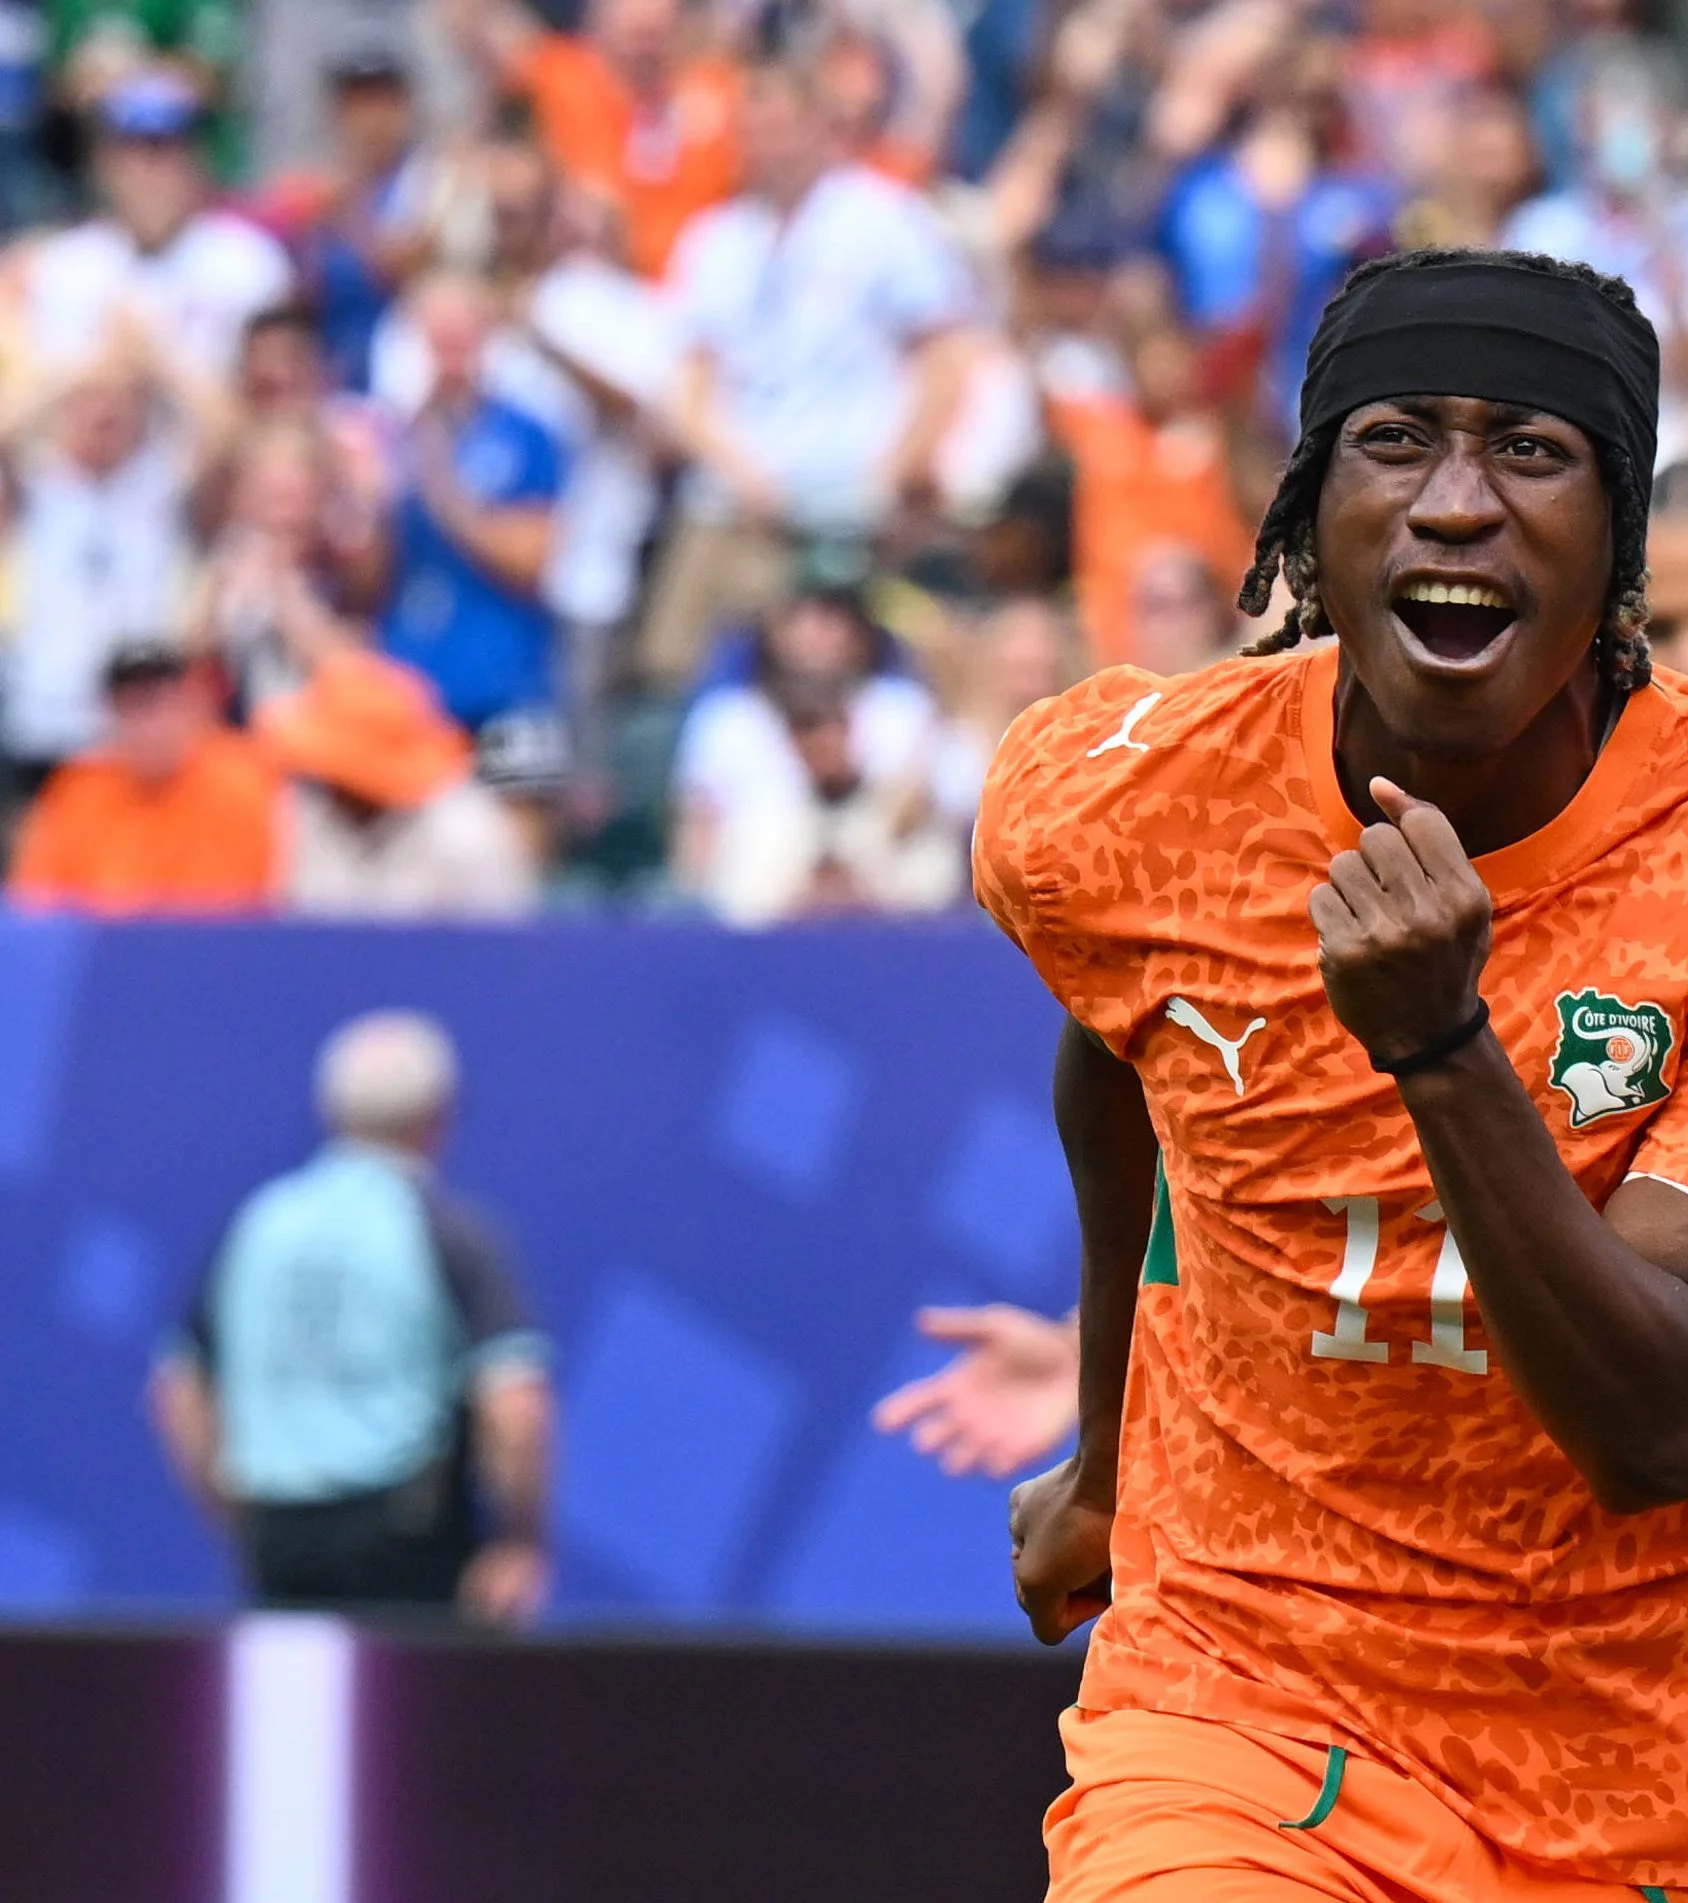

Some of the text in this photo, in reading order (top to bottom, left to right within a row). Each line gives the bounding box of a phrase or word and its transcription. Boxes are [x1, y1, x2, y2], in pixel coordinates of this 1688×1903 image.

[1573, 1006, 1656, 1034] CÔTE D'IVOIRE
[1311, 1197, 1488, 1375] 11
